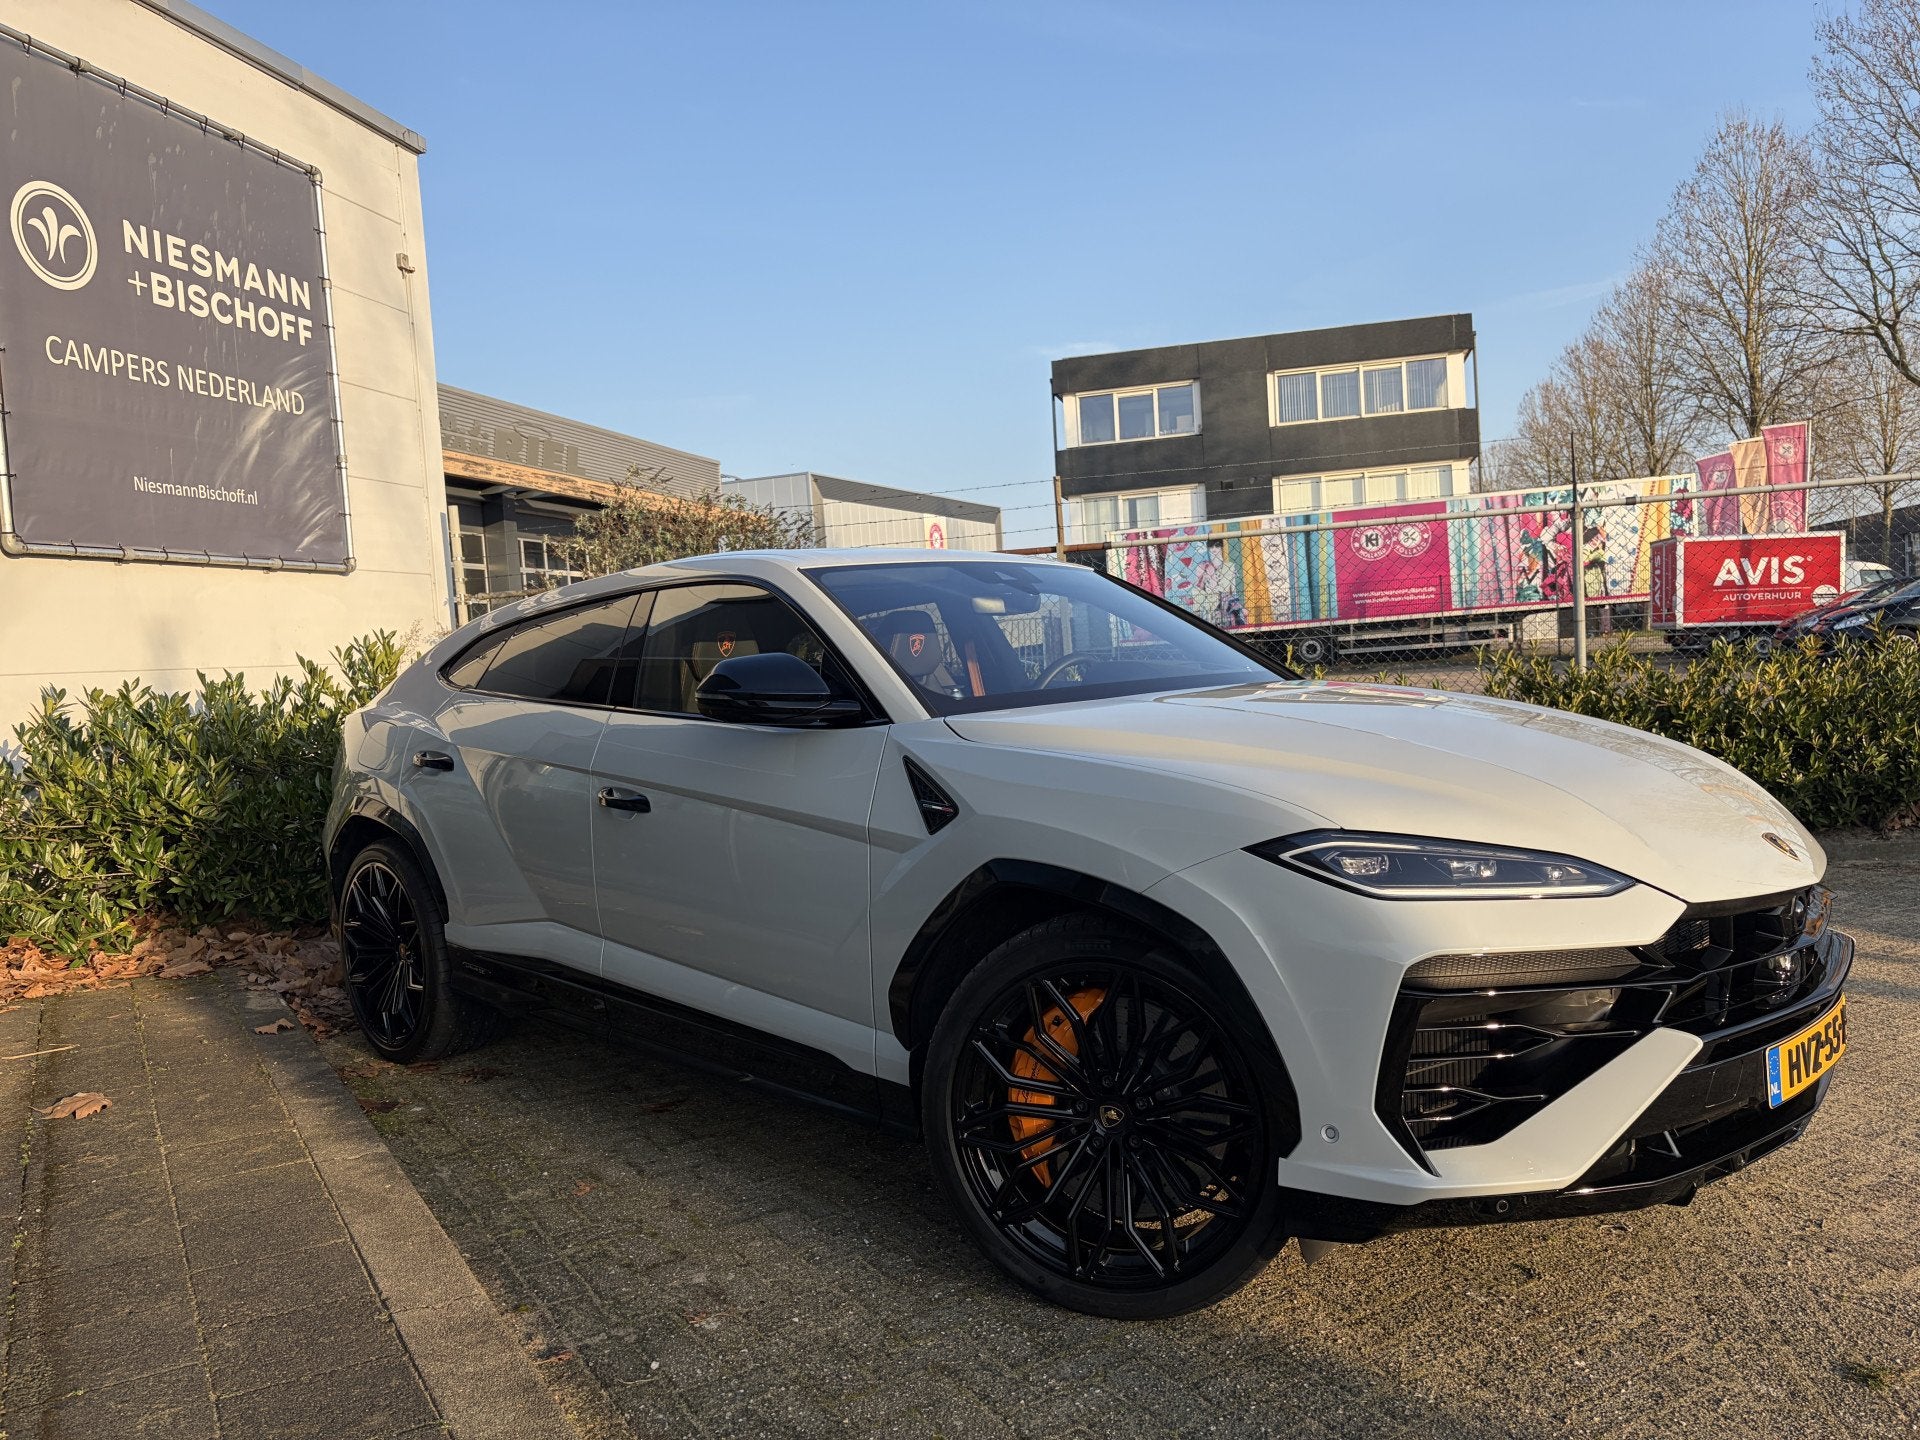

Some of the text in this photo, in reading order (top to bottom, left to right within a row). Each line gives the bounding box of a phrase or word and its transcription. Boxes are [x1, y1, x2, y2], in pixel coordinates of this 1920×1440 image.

[122, 219, 312, 311] NIESMANN
[127, 270, 313, 346] +BISCHOFF
[45, 335, 306, 416] CAMPERS NEDERLAND
[495, 427, 587, 477] RIEL
[133, 476, 259, 506] NiesmannBischoff.nl
[1713, 555, 1806, 587] AVIS
[1722, 591, 1802, 602] AUTOVERHUUR
[1787, 1003, 1848, 1089] HVZ-55-
[1770, 1081, 1781, 1097] NL
